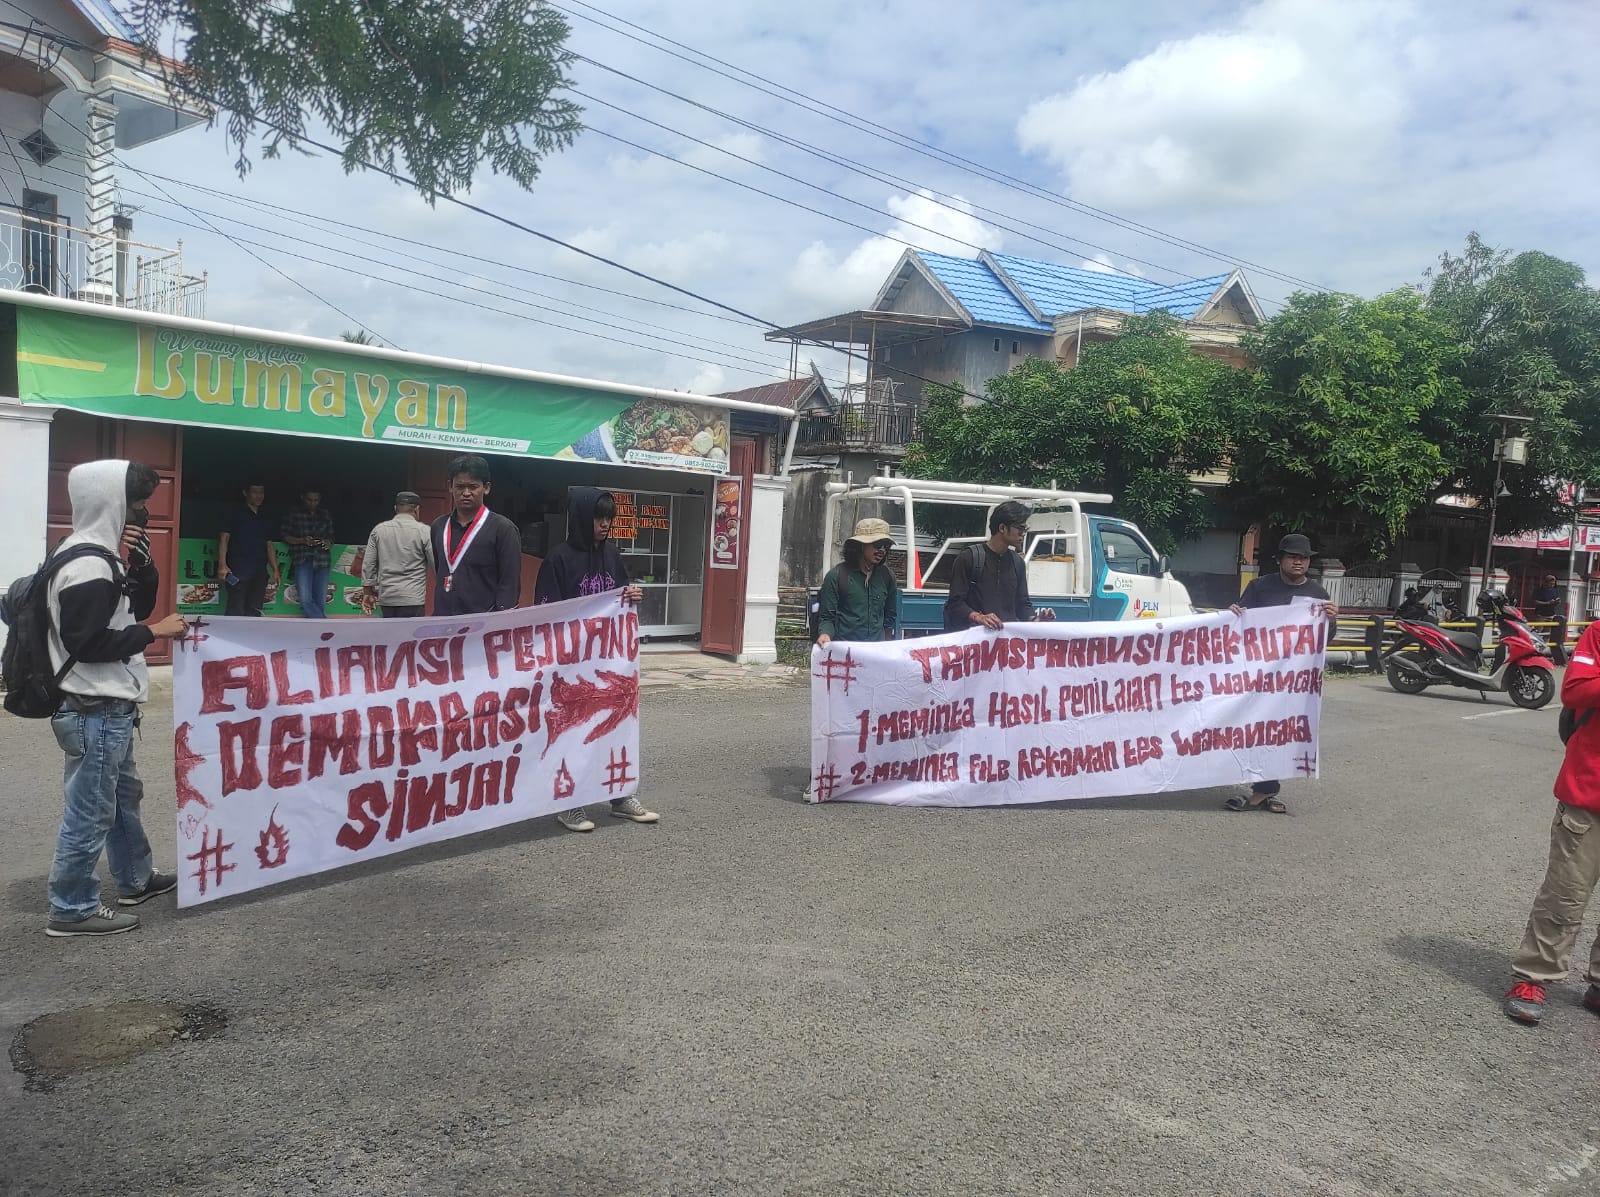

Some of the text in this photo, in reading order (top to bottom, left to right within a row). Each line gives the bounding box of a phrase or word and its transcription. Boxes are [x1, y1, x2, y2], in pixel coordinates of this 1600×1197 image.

[158, 330, 308, 367] Warung Makan
[134, 325, 468, 438] Lumayan
[398, 430, 518, 448] MURAH KENYANG BERKAH
[1143, 601, 1159, 611] PLN
